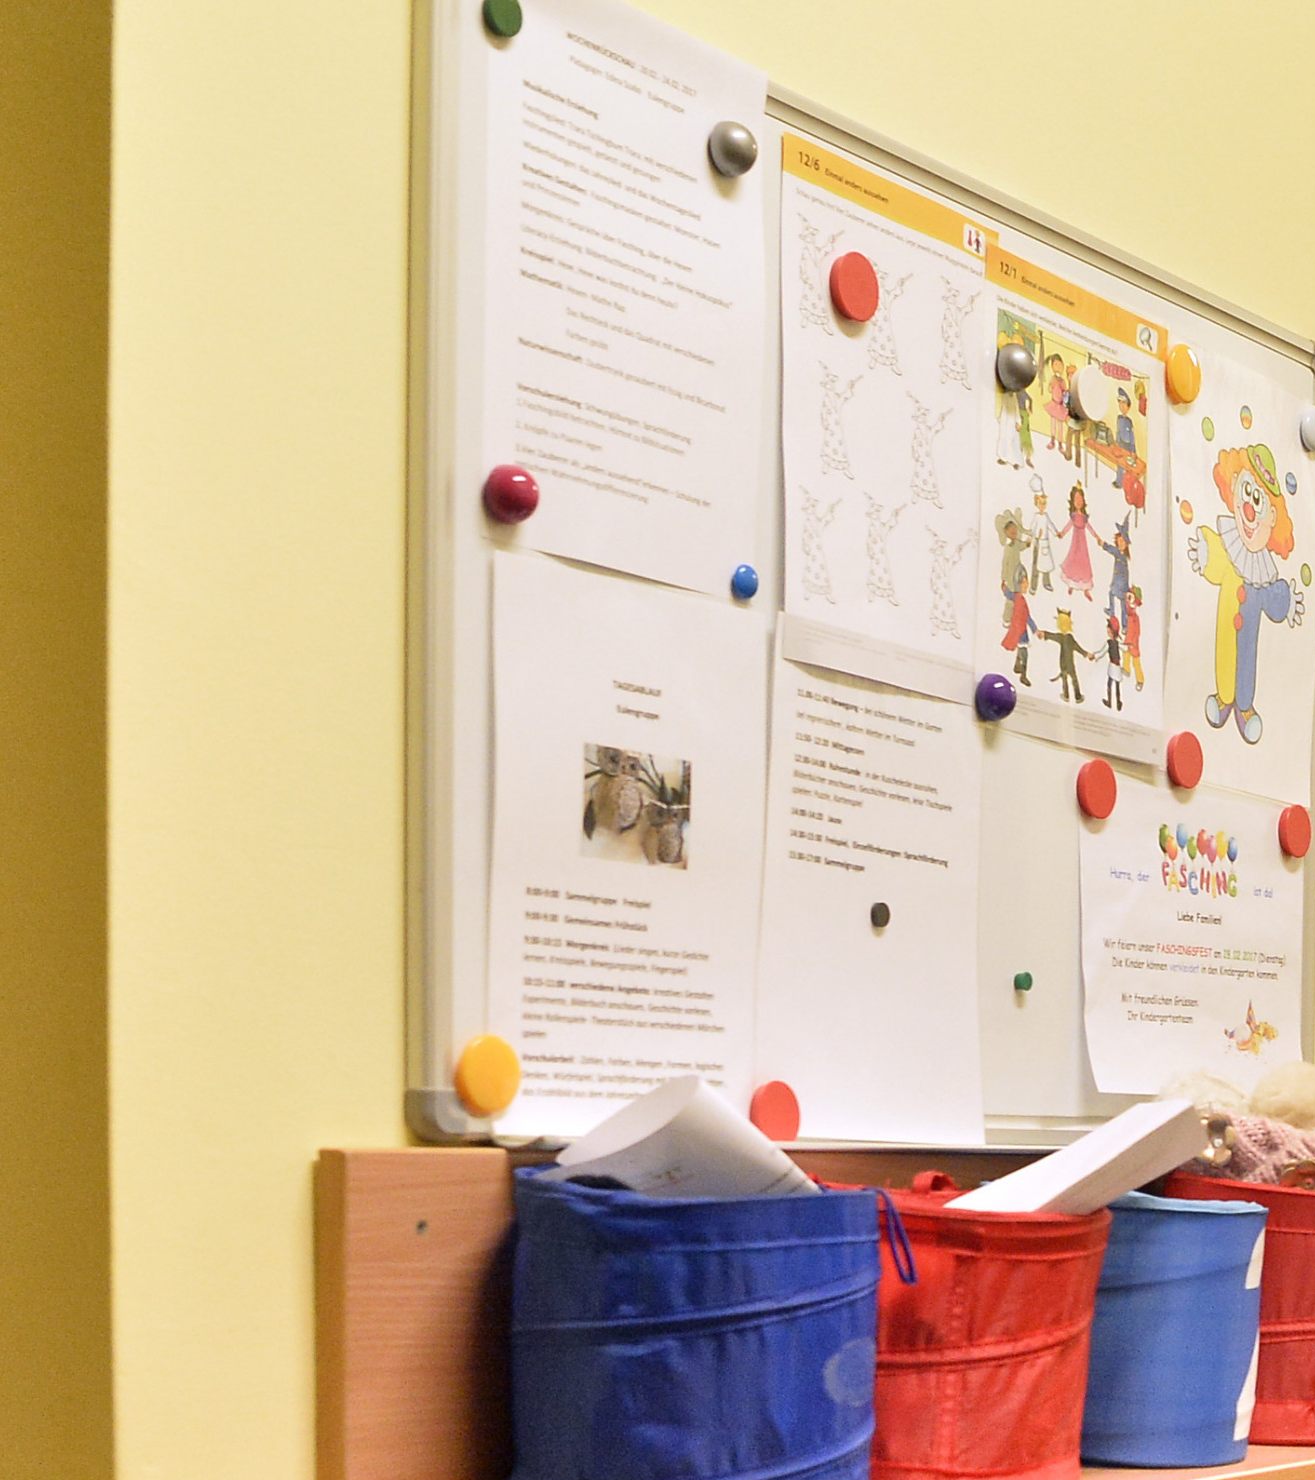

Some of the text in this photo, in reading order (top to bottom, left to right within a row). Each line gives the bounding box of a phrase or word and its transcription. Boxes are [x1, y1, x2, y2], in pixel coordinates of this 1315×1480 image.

[799, 151, 821, 172] 12/6
[825, 167, 844, 183] Einmal
[845, 177, 863, 193] anders
[1000, 261, 1018, 279] 12/1
[1020, 276, 1037, 290] Einmal
[1137, 870, 1150, 881] der
[1161, 861, 1238, 898] FASCHING
[1177, 911, 1222, 925] Liebe Familien!
[1103, 937, 1117, 948] Wir
[1117, 938, 1137, 951] feiern
[1138, 943, 1155, 953] unser
[1156, 943, 1213, 958] FASCHINGSFEST
[1214, 950, 1222, 959] am
[1112, 957, 1123, 968] Die
[1124, 958, 1145, 970] Kinder
[1146, 959, 1168, 971] können
[1208, 966, 1218, 975] den
[1219, 966, 1255, 979] Kindergarten
[1121, 992, 1133, 1003] Mit
[1134, 992, 1173, 1006] freundlichen
[1127, 1010, 1194, 1025] Ihr Kindergartenteam
